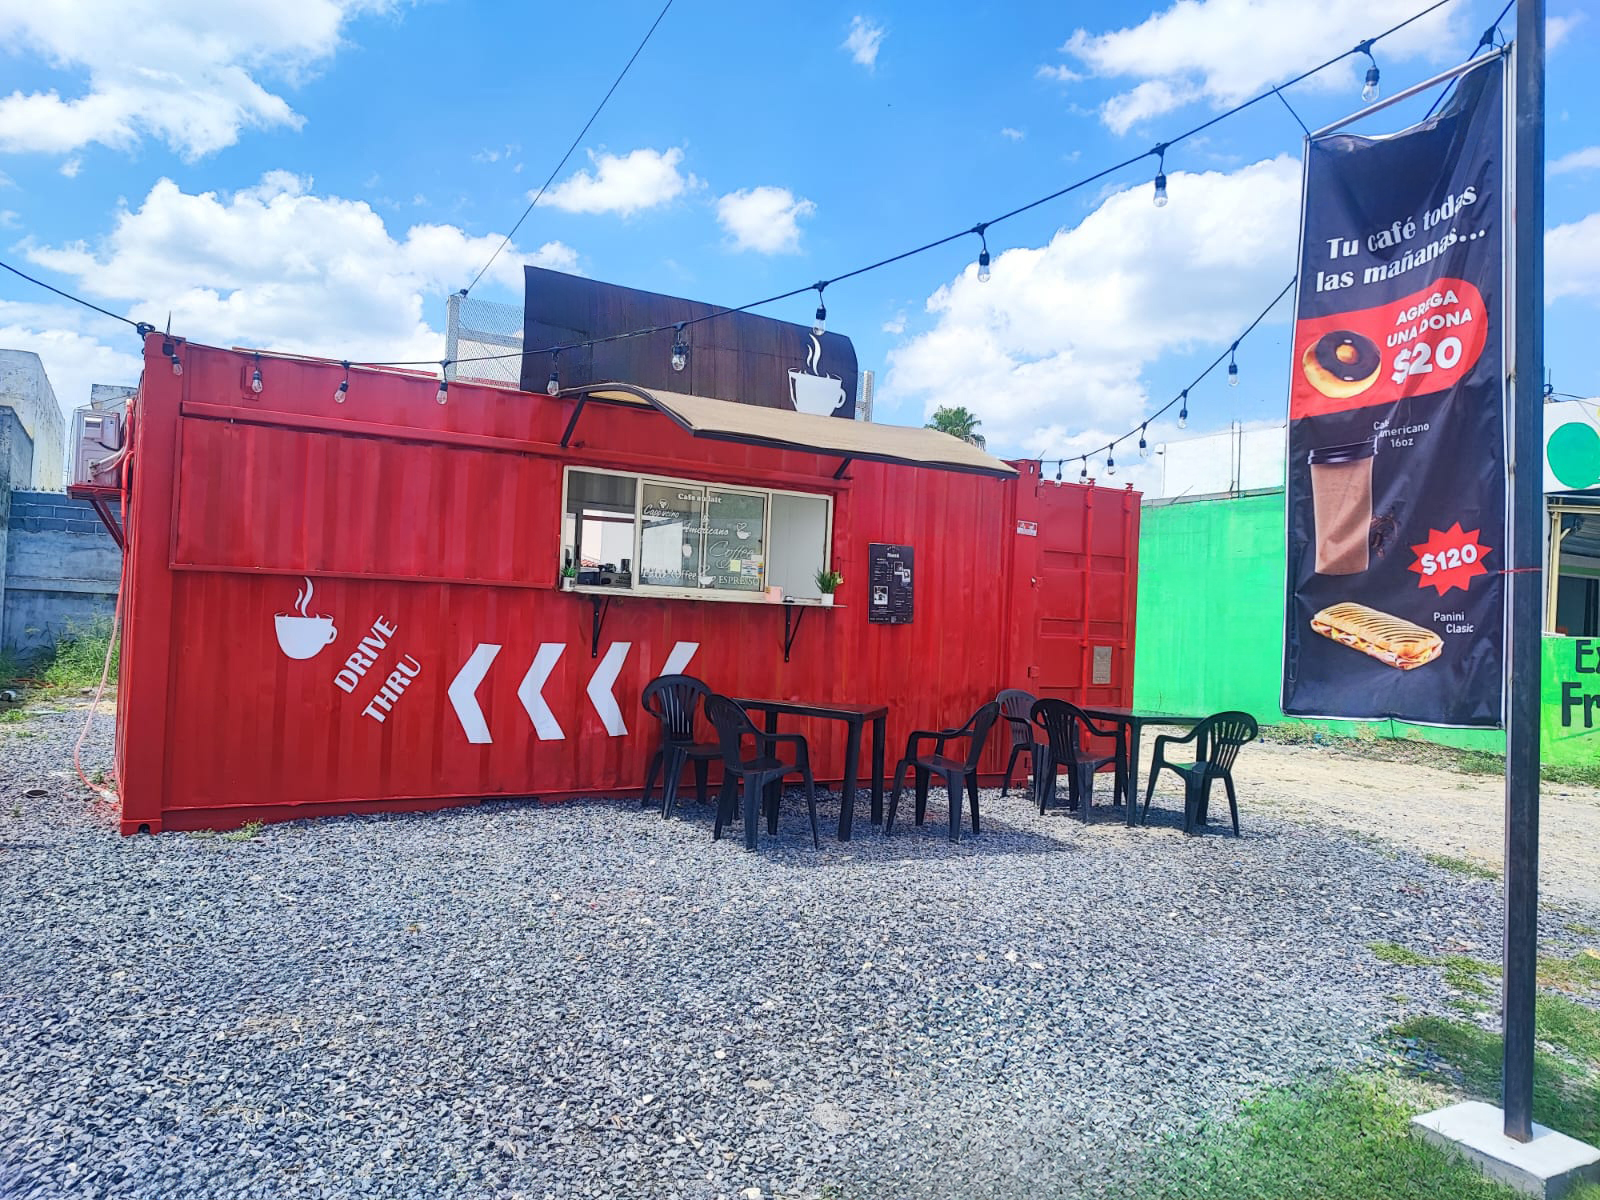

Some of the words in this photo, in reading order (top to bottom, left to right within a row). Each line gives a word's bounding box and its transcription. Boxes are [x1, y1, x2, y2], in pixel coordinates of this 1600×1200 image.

[1326, 237, 1359, 259] Tu
[1367, 216, 1417, 251] café
[1423, 185, 1477, 231] todas
[1316, 271, 1354, 292] las
[1363, 227, 1486, 284] mañanas...
[1395, 289, 1459, 326] AGREGA
[1387, 325, 1418, 347] UNA
[1419, 308, 1472, 334] DONA
[1391, 336, 1462, 385] $20
[1390, 438, 1415, 448] 16oz
[1421, 543, 1478, 576] $120
[1433, 610, 1465, 622] Panini
[1445, 623, 1474, 633] Clasic
[334, 615, 398, 694] DRIVE
[360, 653, 422, 724] THRU
